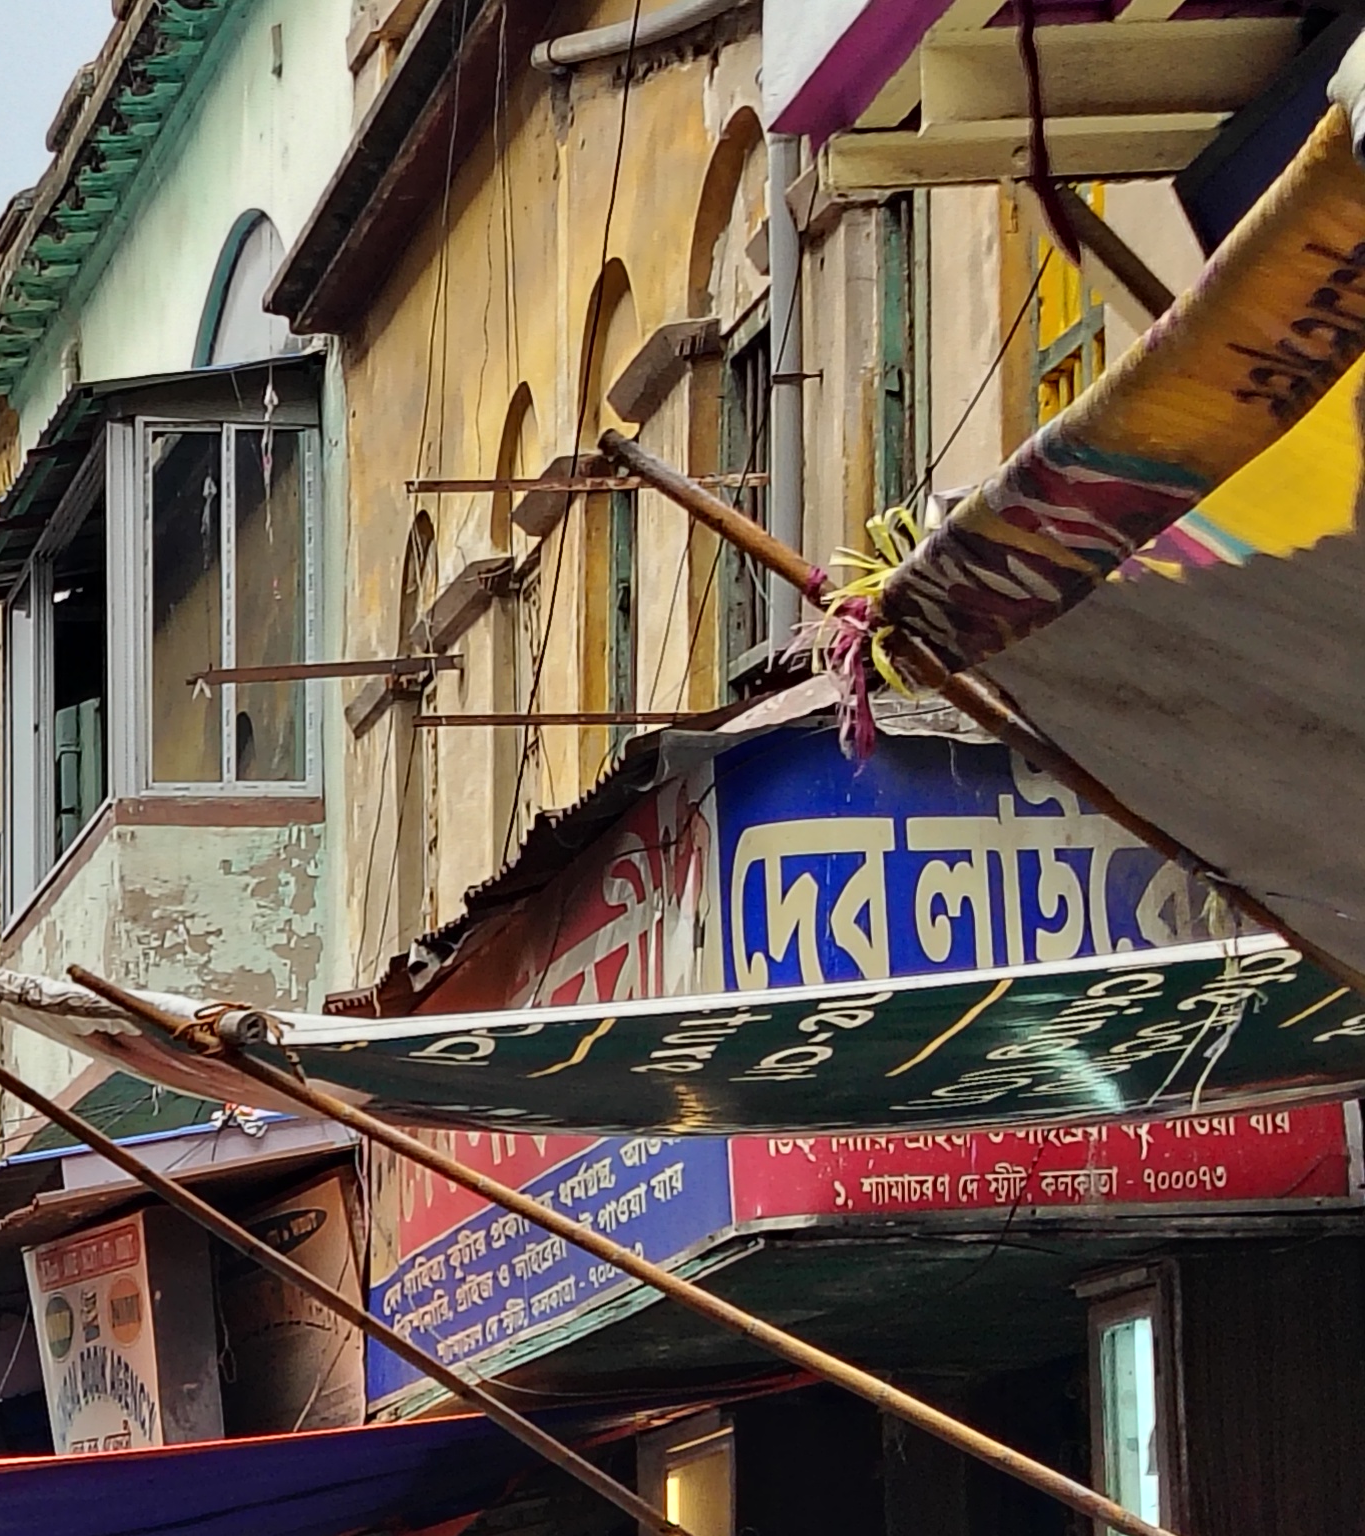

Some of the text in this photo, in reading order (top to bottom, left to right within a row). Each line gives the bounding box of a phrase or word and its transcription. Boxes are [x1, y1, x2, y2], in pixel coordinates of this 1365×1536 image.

[957, 1171, 978, 1201] দে
[1038, 1166, 1119, 1196] কলকাতা
[1142, 1167, 1228, 1193] ৭০০০৭৩
